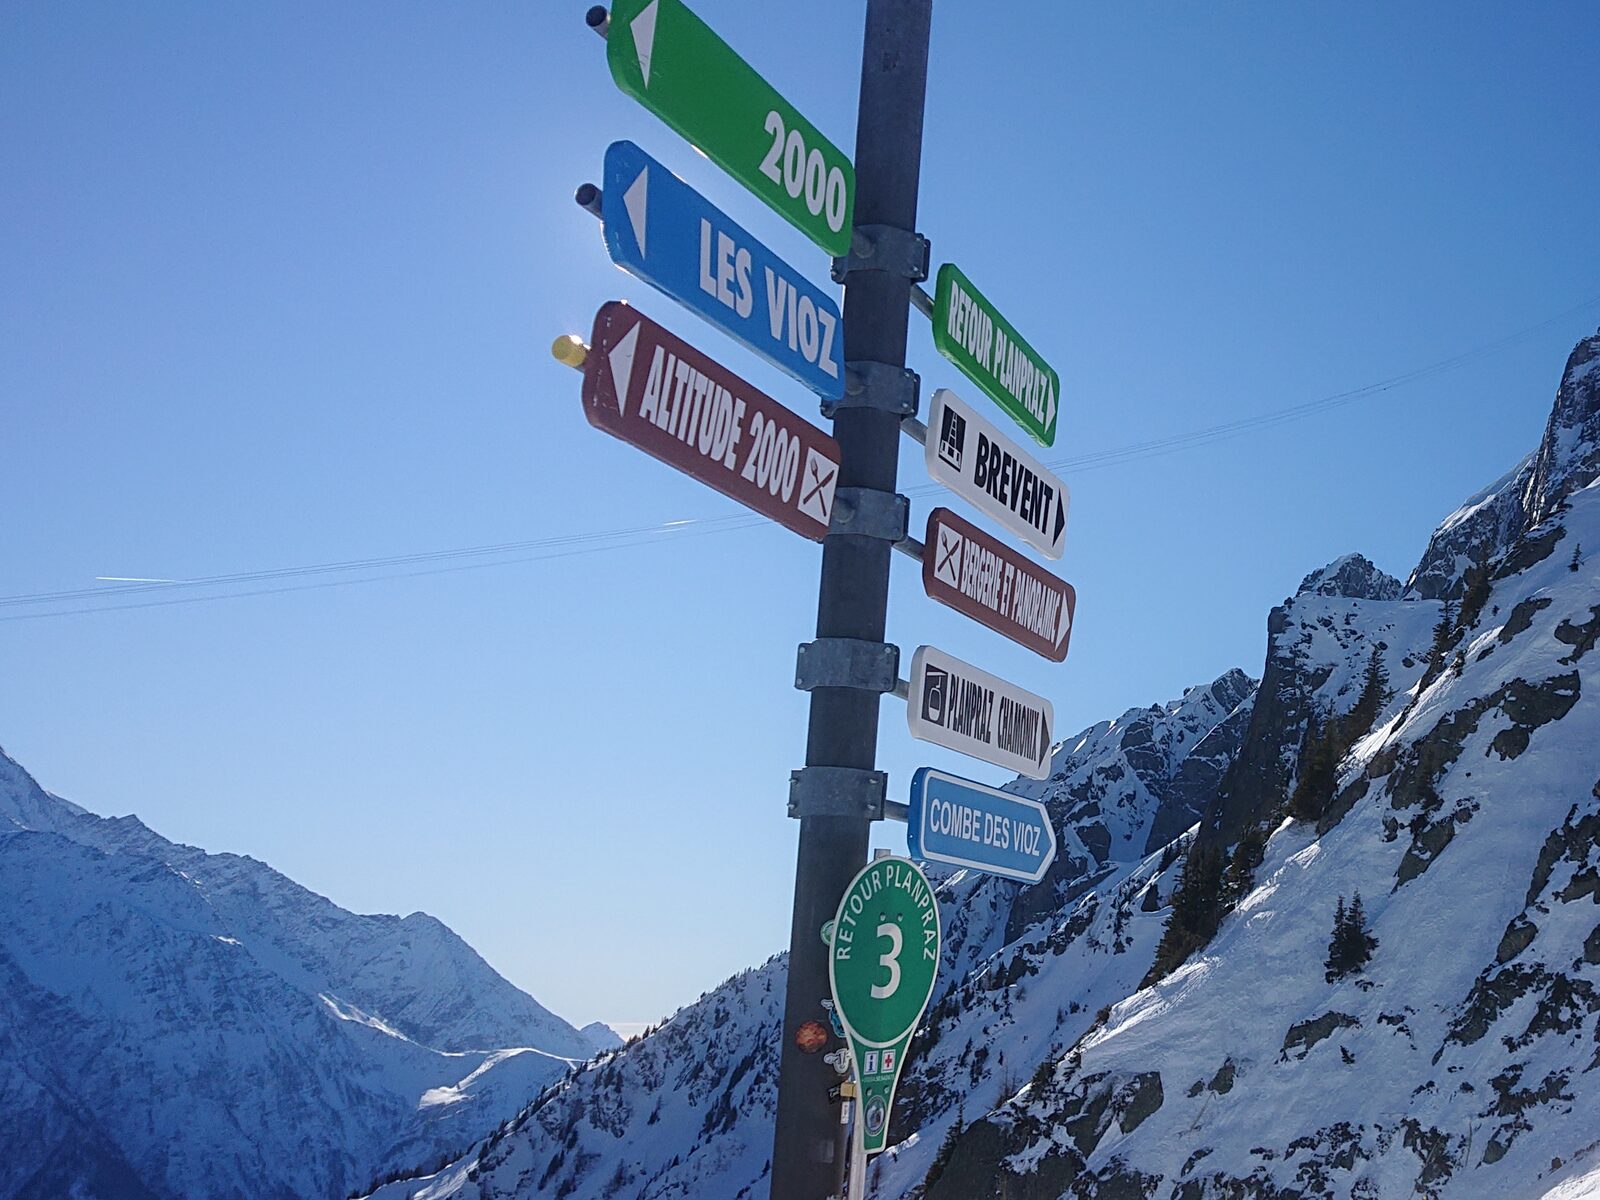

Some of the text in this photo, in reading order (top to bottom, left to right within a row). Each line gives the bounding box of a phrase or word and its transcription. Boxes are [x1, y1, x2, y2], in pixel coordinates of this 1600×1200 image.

[759, 110, 846, 232] 2000
[700, 218, 838, 379] LES VIOZ
[948, 279, 1048, 425] RETOUR PLANPRAZ
[639, 345, 800, 503] ALTITUDE 2000
[974, 432, 1054, 535] BREVENT
[960, 538, 1061, 643] BERGERIE ET PANORAMIC
[947, 673, 1040, 762] PLANPRAZ CHAMONIX
[930, 798, 1041, 857] COMBE DES VIOZ
[836, 865, 936, 960] RETOUR PLANPRAZ
[870, 922, 903, 999] 3
